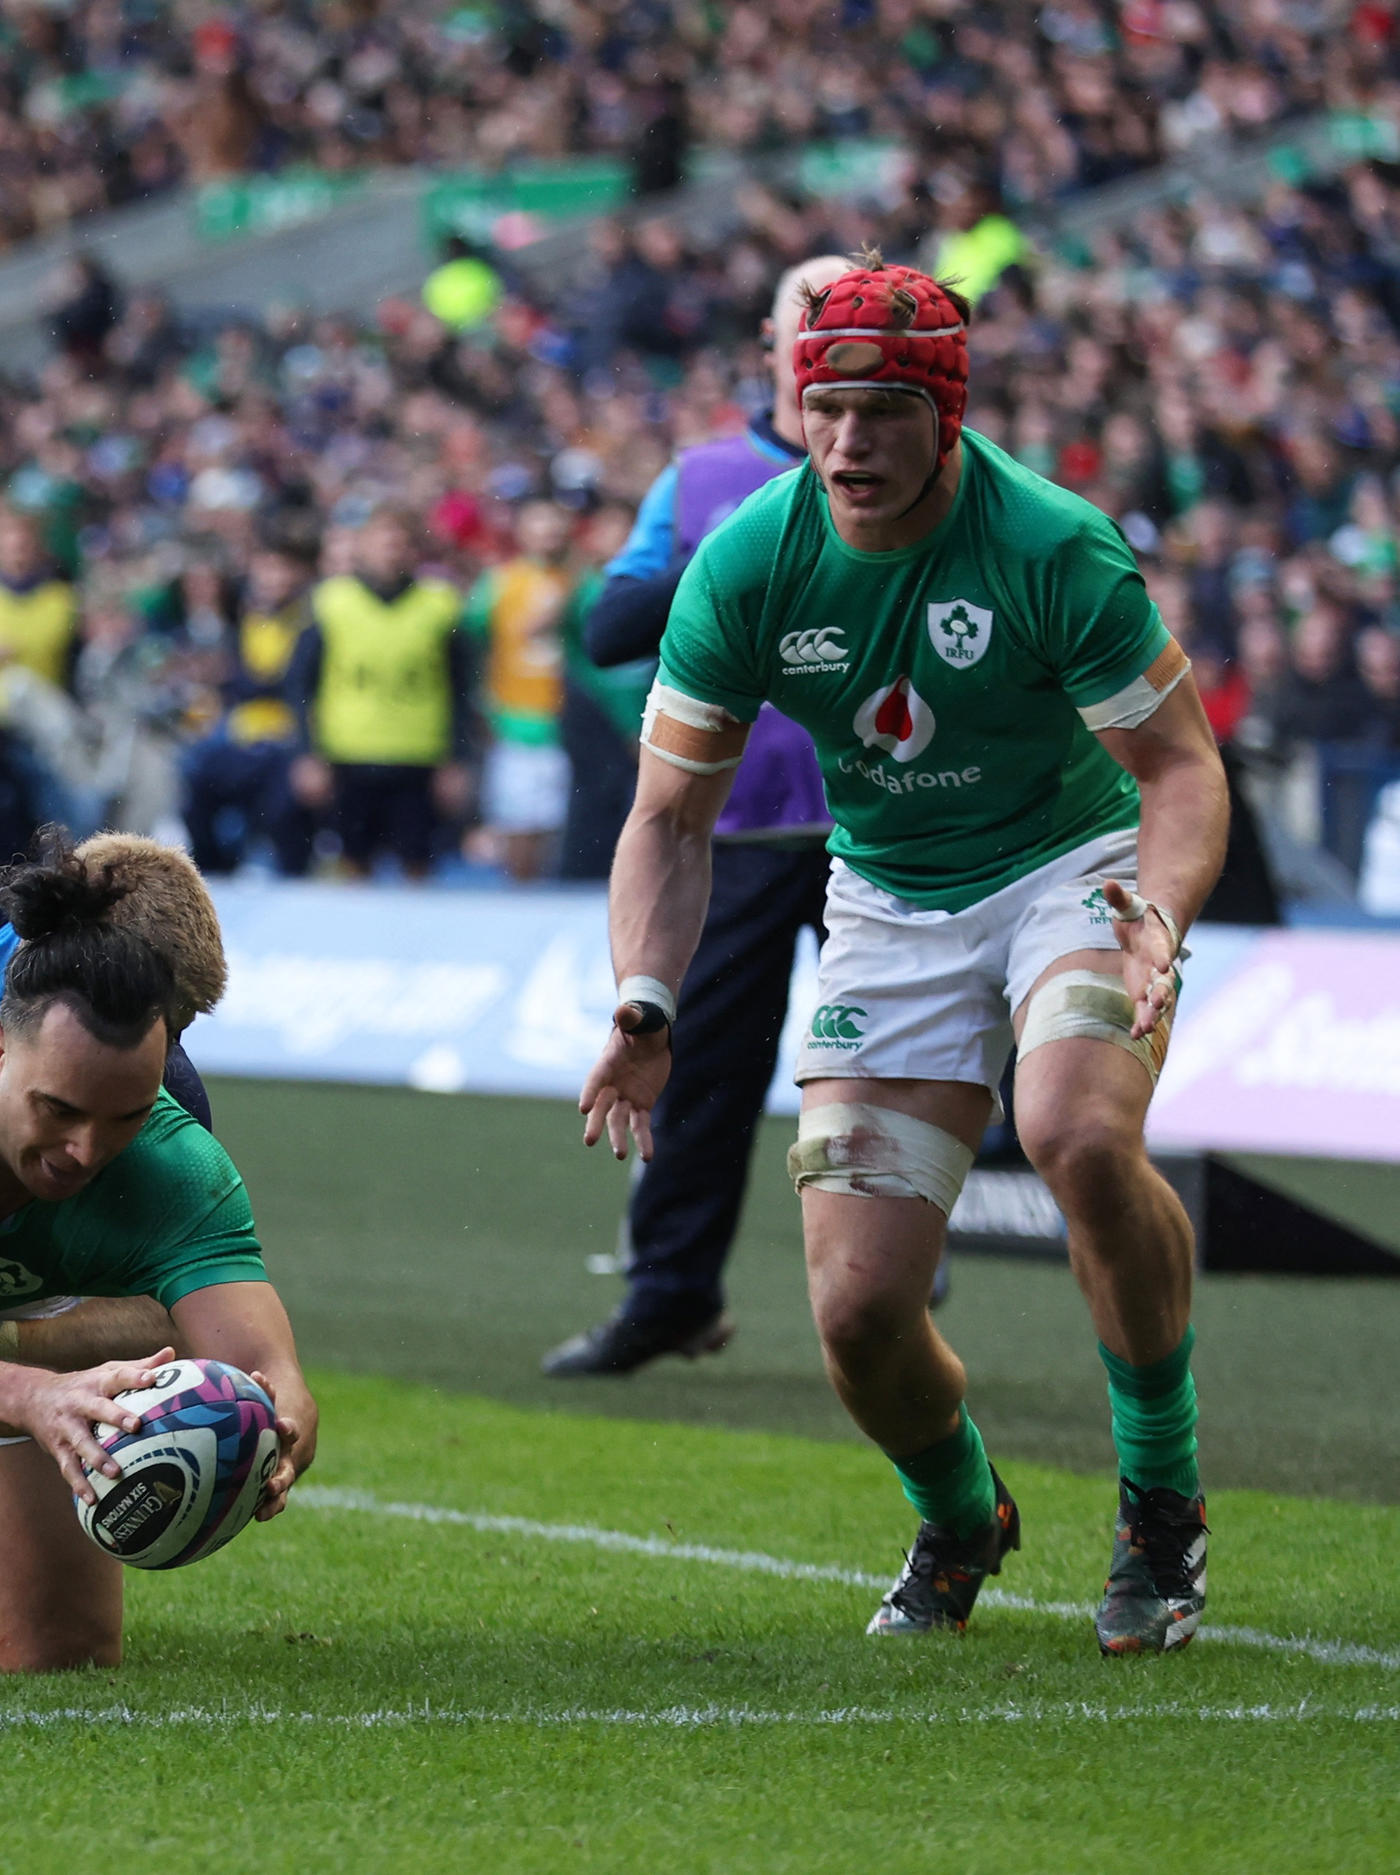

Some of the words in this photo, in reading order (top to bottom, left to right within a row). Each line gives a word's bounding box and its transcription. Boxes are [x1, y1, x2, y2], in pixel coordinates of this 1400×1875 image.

[945, 647, 975, 661] IRFU
[782, 662, 851, 676] canterbury
[807, 1040, 863, 1052] canterbury
[129, 1482, 147, 1501] SIX
[101, 1497, 134, 1529] NATIONS
[113, 1496, 163, 1541] GUINNESS
